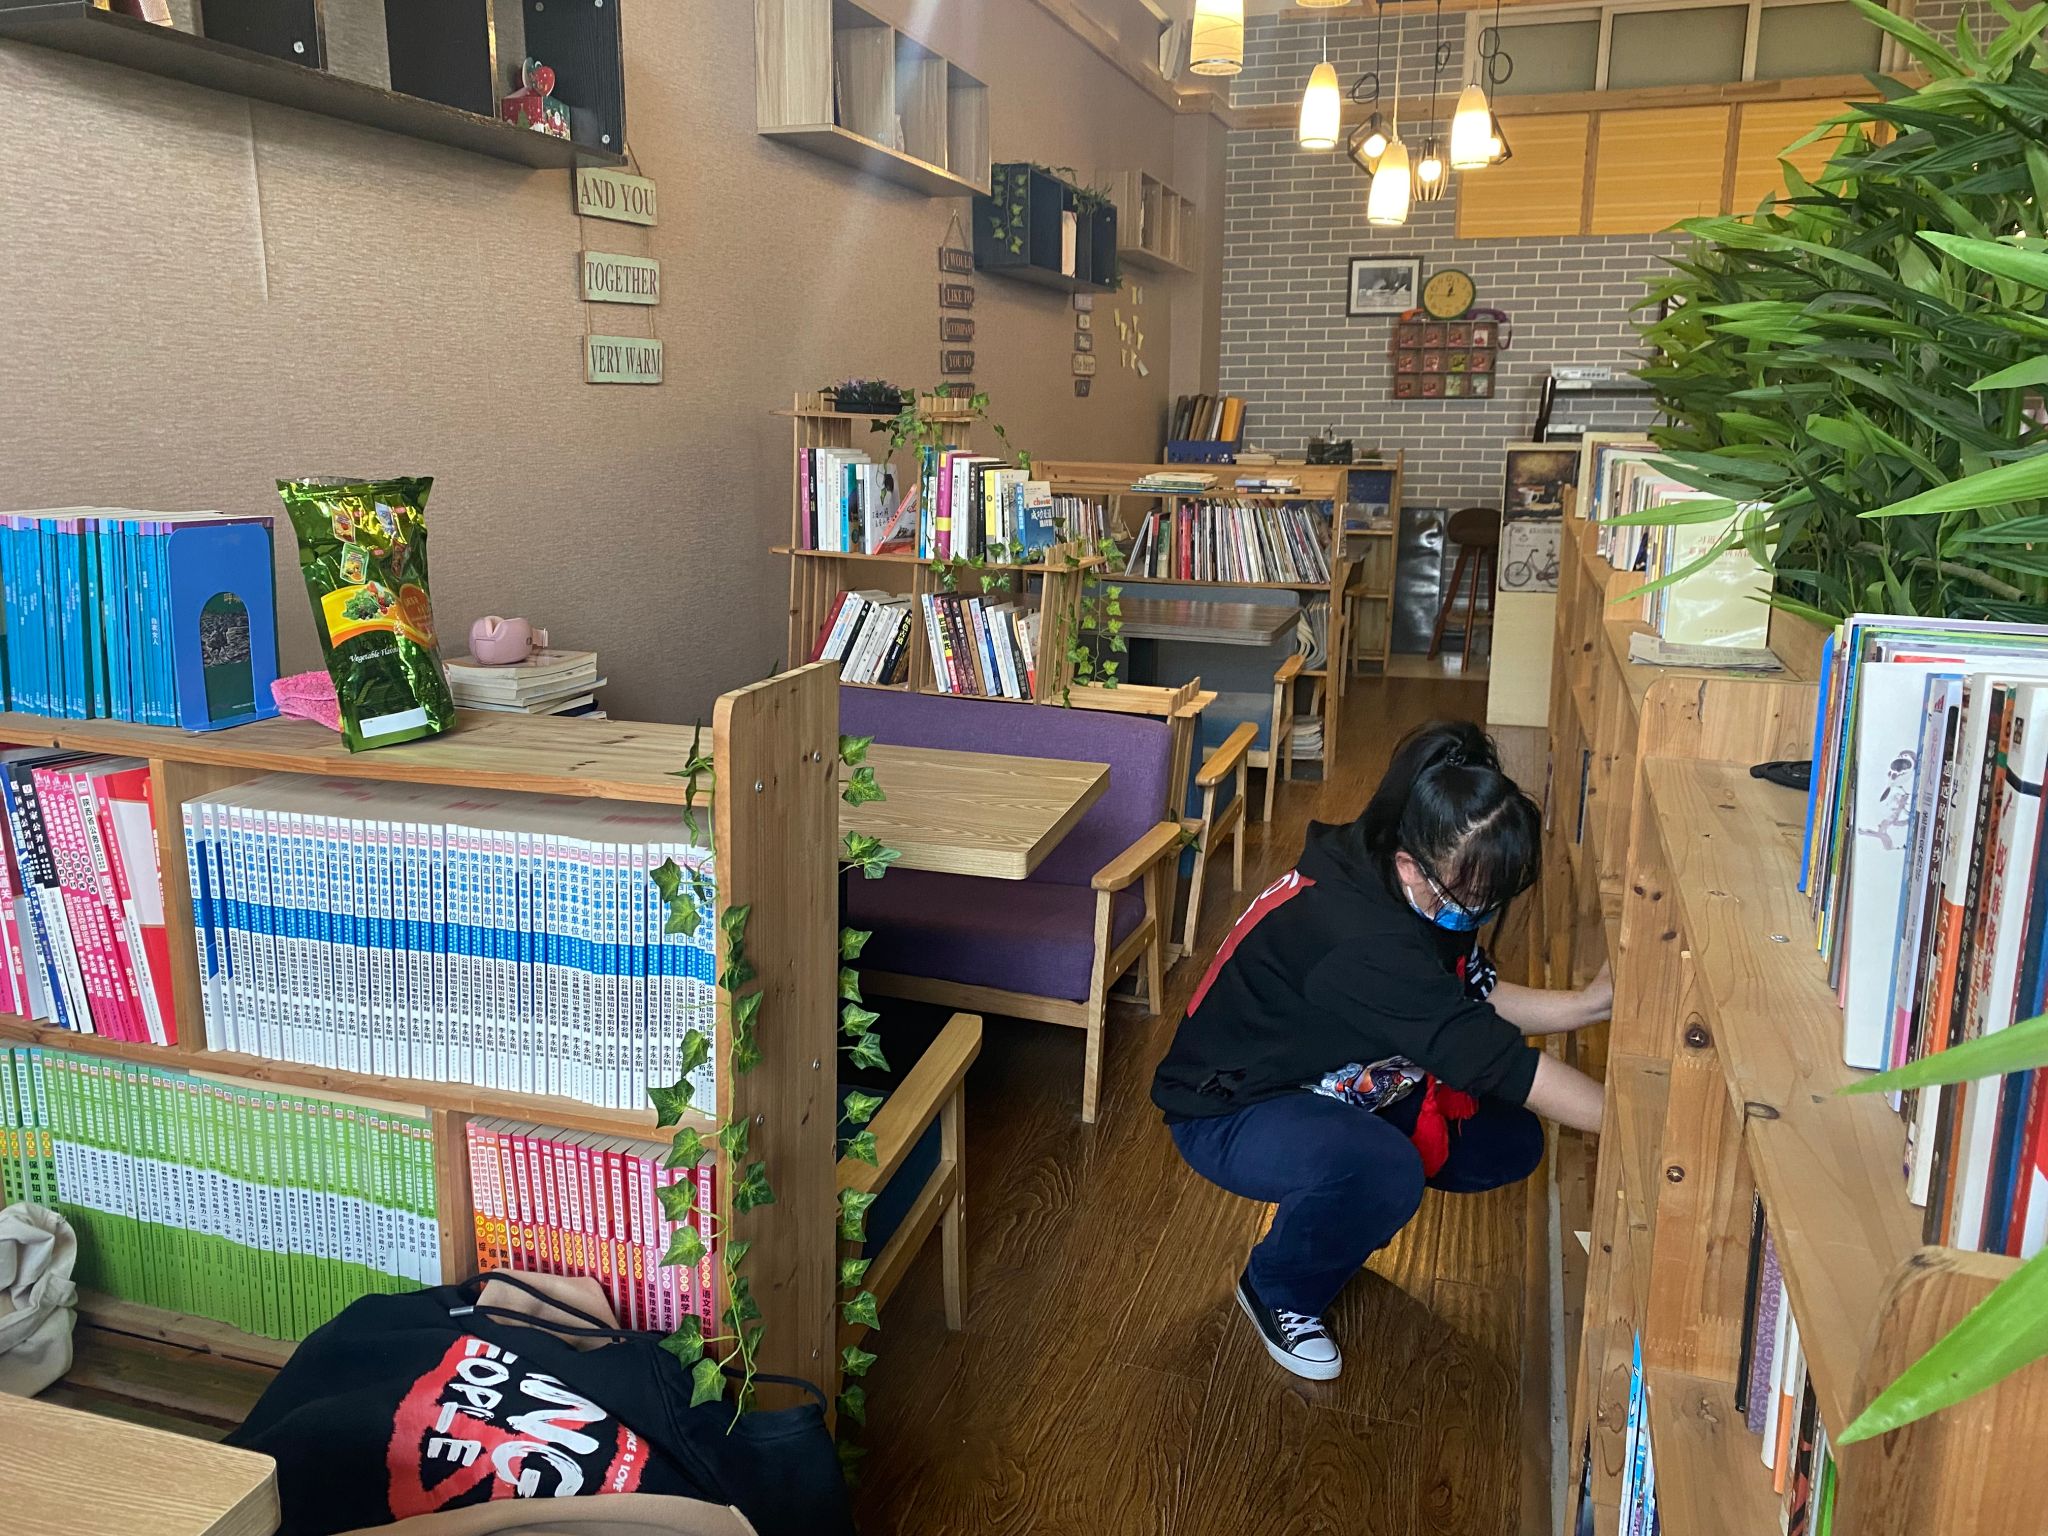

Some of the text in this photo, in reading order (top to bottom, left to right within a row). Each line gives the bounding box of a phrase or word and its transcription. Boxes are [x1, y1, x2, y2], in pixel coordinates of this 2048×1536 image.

[581, 175, 655, 216] AND YOU
[586, 261, 657, 295] TOGETHER
[950, 254, 973, 270] WOULD
[946, 289, 973, 304] LIKE TO
[590, 344, 661, 375] VERY WARM
[948, 354, 972, 368] YOU TO
[349, 649, 380, 664] Vegetable
[15, 796, 34, 850] 国家公务员
[26, 799, 46, 854] 国家公务员
[82, 798, 101, 853] 陕西省公务员
[185, 828, 199, 897] 陕西省事业单位
[205, 828, 218, 897] 陕西省事业单位
[220, 828, 233, 898] 陕西省事业单位
[233, 830, 245, 900] 陕西省事业单位
[244, 832, 258, 902] 陕西省事业单位
[256, 834, 270, 904] 陕西省事业单位
[269, 835, 283, 905] 陕西省事业单位
[281, 838, 294, 907] 陕西省事业单位
[293, 837, 305, 907] 陕西省事业单位
[305, 838, 316, 909] 陕西省事业单位
[316, 840, 327, 910] 陕西省事业单位
[329, 841, 339, 912] 陕西省事业单位
[341, 842, 352, 913] 陕西省事业单位
[354, 845, 364, 917] 陕西省事业单位
[367, 846, 377, 918] 陕西省事业单位
[379, 846, 390, 918] 陕西省事业单位
[393, 846, 404, 918] 陕西省事业单位
[407, 848, 417, 919] 陕西省事业单位
[419, 849, 429, 921] 陕西省事业单位
[433, 850, 443, 921] 陕西省事业单位
[448, 850, 457, 921] 陕西省事业单位
[459, 852, 468, 924] 陕西省事业单位
[470, 852, 480, 924] 陕西省事业单位
[482, 855, 492, 926] 陕西省事业单位
[495, 855, 504, 927] 陕西省事业单位
[505, 856, 514, 928] 陕西省事业单位
[101, 875, 120, 921] 面试通关
[519, 858, 529, 930] 陕西省事业单位
[533, 858, 542, 930] 陕西省事业单位
[547, 860, 556, 933] 陕西省事业单位
[558, 861, 568, 934] 陕西省事业单位
[570, 862, 580, 936] 陕西省事业单位
[580, 865, 590, 938] 陕西省事业单位
[592, 868, 602, 941] 陕西省事业单位
[605, 868, 614, 941] 陕西省事业单位
[619, 868, 629, 942] 陕西省事业单位
[634, 870, 642, 943] 陕西省事业单位
[78, 950, 89, 971] 李永新
[87, 954, 98, 974] 李永新
[96, 955, 107, 975] 李永新
[108, 958, 118, 979] 李永新
[125, 968, 138, 997] 李永新
[197, 930, 208, 987] 公共基础知识考前必背
[231, 930, 242, 987] 公共基础知识考前必背
[254, 935, 265, 992] 公共基础知识考前必背
[300, 941, 311, 998] 公共基础知识考前必背
[322, 943, 331, 1001] 公共基础知识考前必背
[346, 947, 355, 1005] 公共基础知识考前必背
[397, 952, 406, 1010] 公共基础知识考前必背
[422, 954, 431, 1012] 公共基础知识考前必背
[450, 955, 458, 1014] 公共基础知识考前必背
[497, 962, 505, 1020] 公共基础知识考前必背
[522, 965, 530, 1024] 公共基础知识考前必背
[549, 967, 557, 1027] 公共基础知识考前必背
[594, 977, 602, 1037] 公共基础知识考前必背
[621, 978, 629, 1039] 公共基础知识考前必背
[650, 978, 658, 1037] 公共基础知识考前必背
[398, 1016, 407, 1037] 李永新
[462, 1022, 470, 1042] 李永新
[536, 1031, 544, 1051] 李永新
[607, 1044, 615, 1065] 李永新
[29, 1160, 42, 1203] 保教知识
[189, 1215, 197, 1226] 小学
[261, 1234, 270, 1245] 小学
[318, 1241, 325, 1253] 中学
[386, 1214, 394, 1249] 综合知识
[398, 1214, 406, 1249] 综合知识
[408, 1218, 416, 1253] 综合知识
[419, 1222, 427, 1257] 综合知识
[429, 1224, 437, 1259] 综合知识
[356, 1247, 363, 1259] 中学
